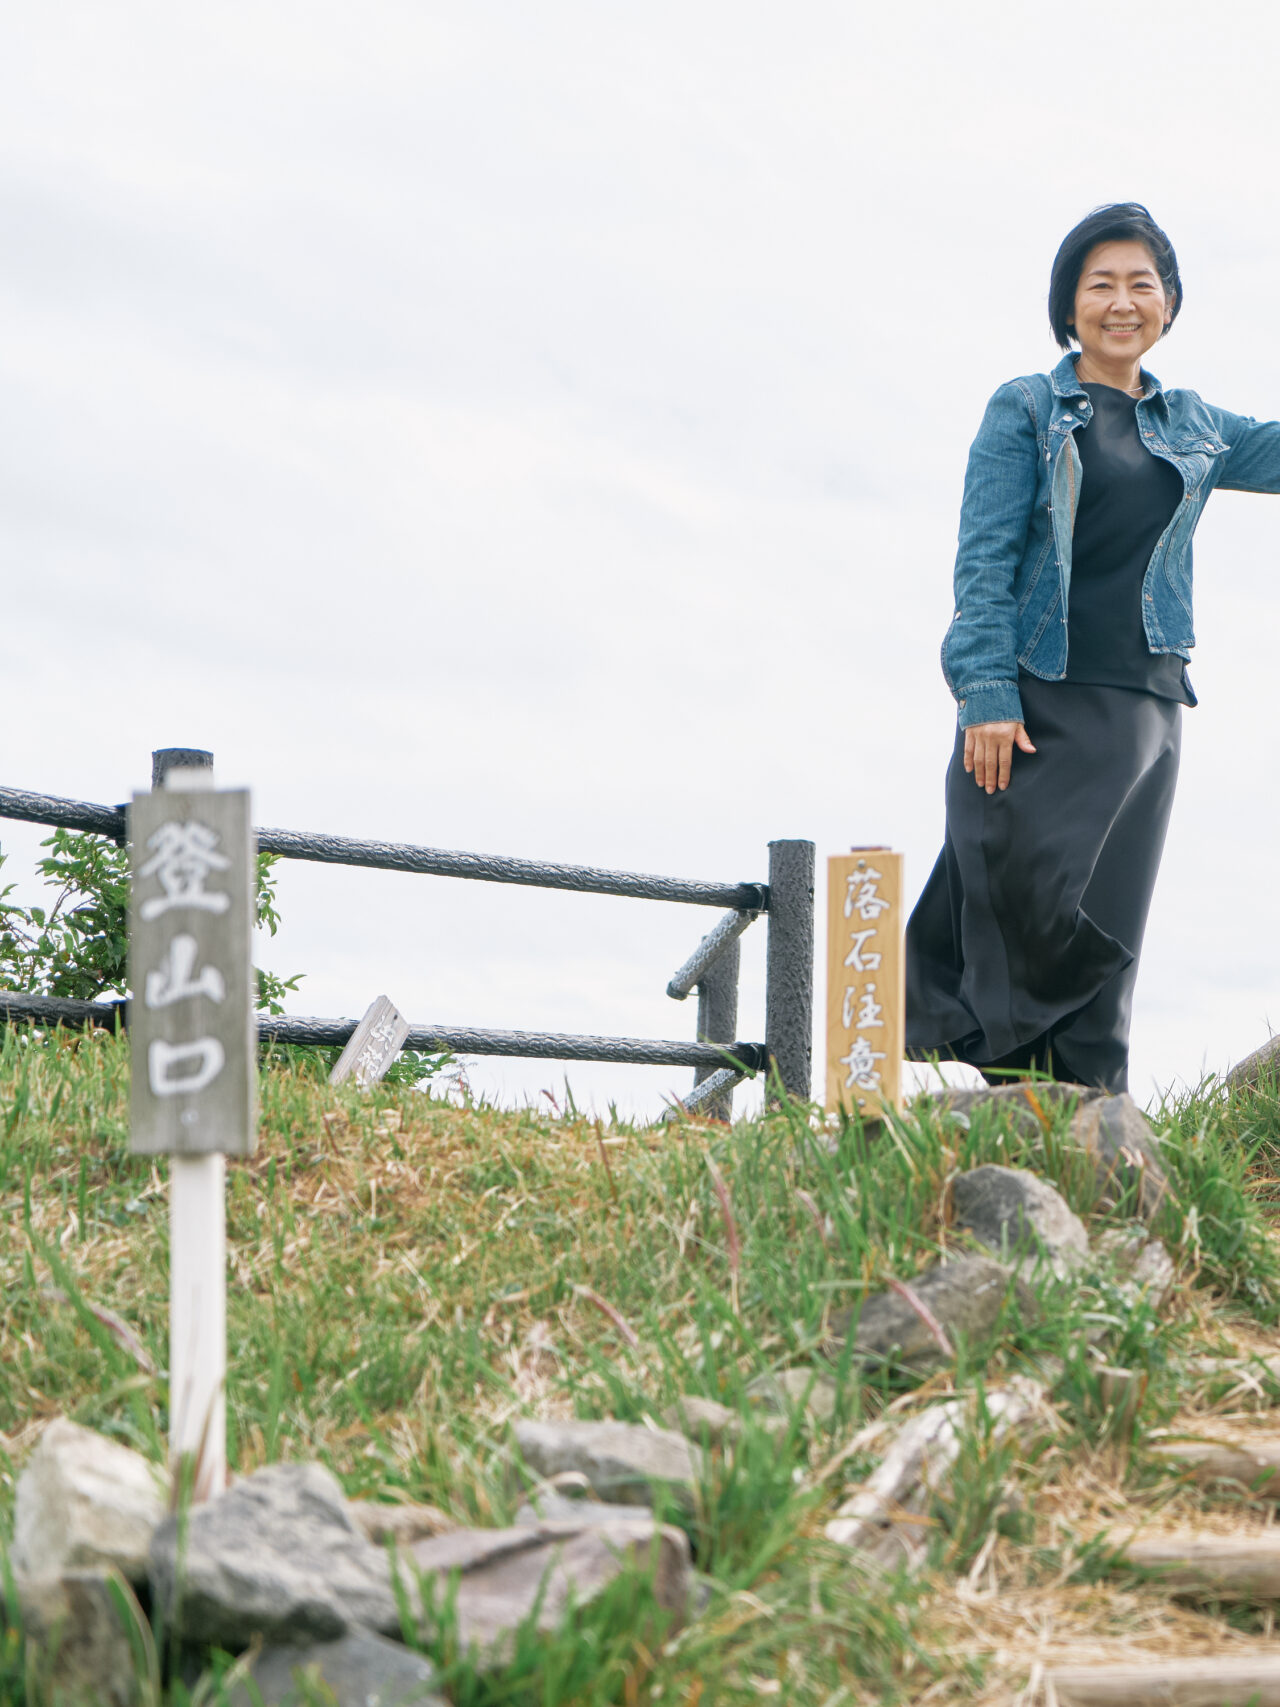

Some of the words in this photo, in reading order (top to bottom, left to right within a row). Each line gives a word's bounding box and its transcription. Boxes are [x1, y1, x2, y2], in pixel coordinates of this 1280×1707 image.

[139, 819, 230, 1096] 登山口
[840, 866, 889, 1093] 落石注意
